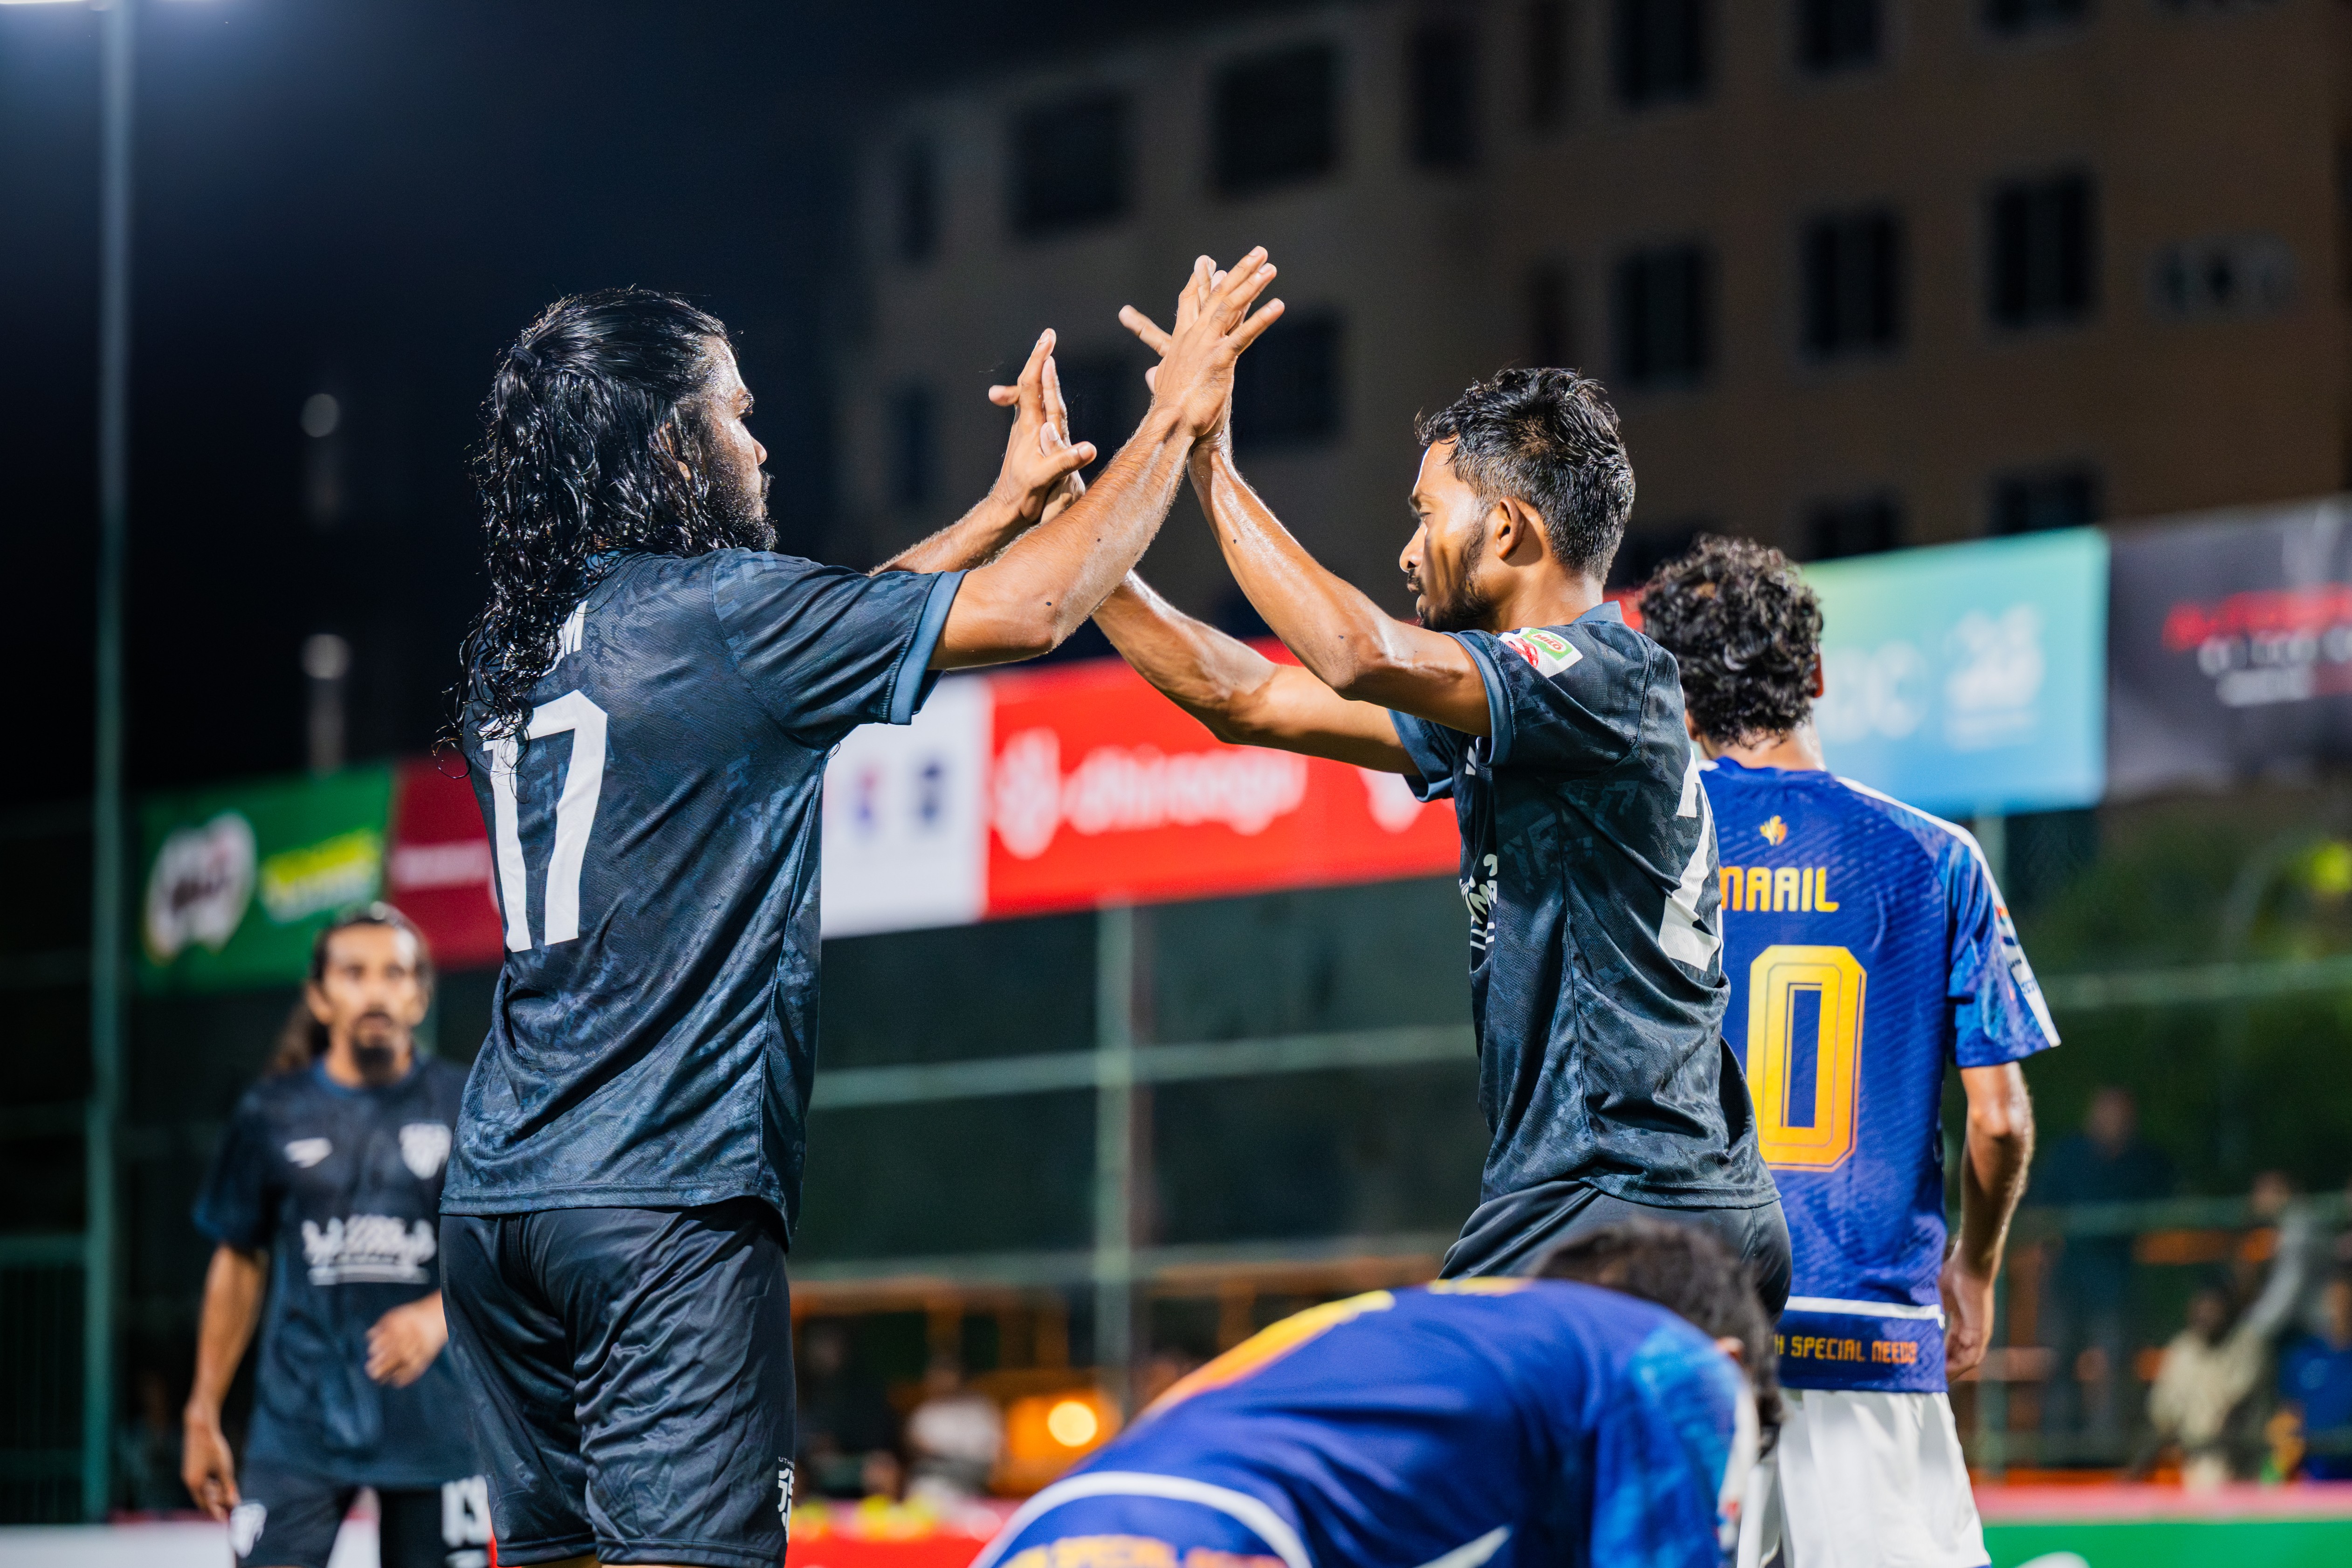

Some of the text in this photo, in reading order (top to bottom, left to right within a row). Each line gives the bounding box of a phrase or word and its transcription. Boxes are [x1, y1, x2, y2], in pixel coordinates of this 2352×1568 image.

[1533, 634, 1562, 651] MILO
[479, 689, 608, 952] 17
[1658, 747, 1724, 977] 2
[1719, 866, 1839, 912] MAAIL
[1791, 1336, 1865, 1362] SPECIAL
[1871, 1340, 1918, 1364] NEEDS
